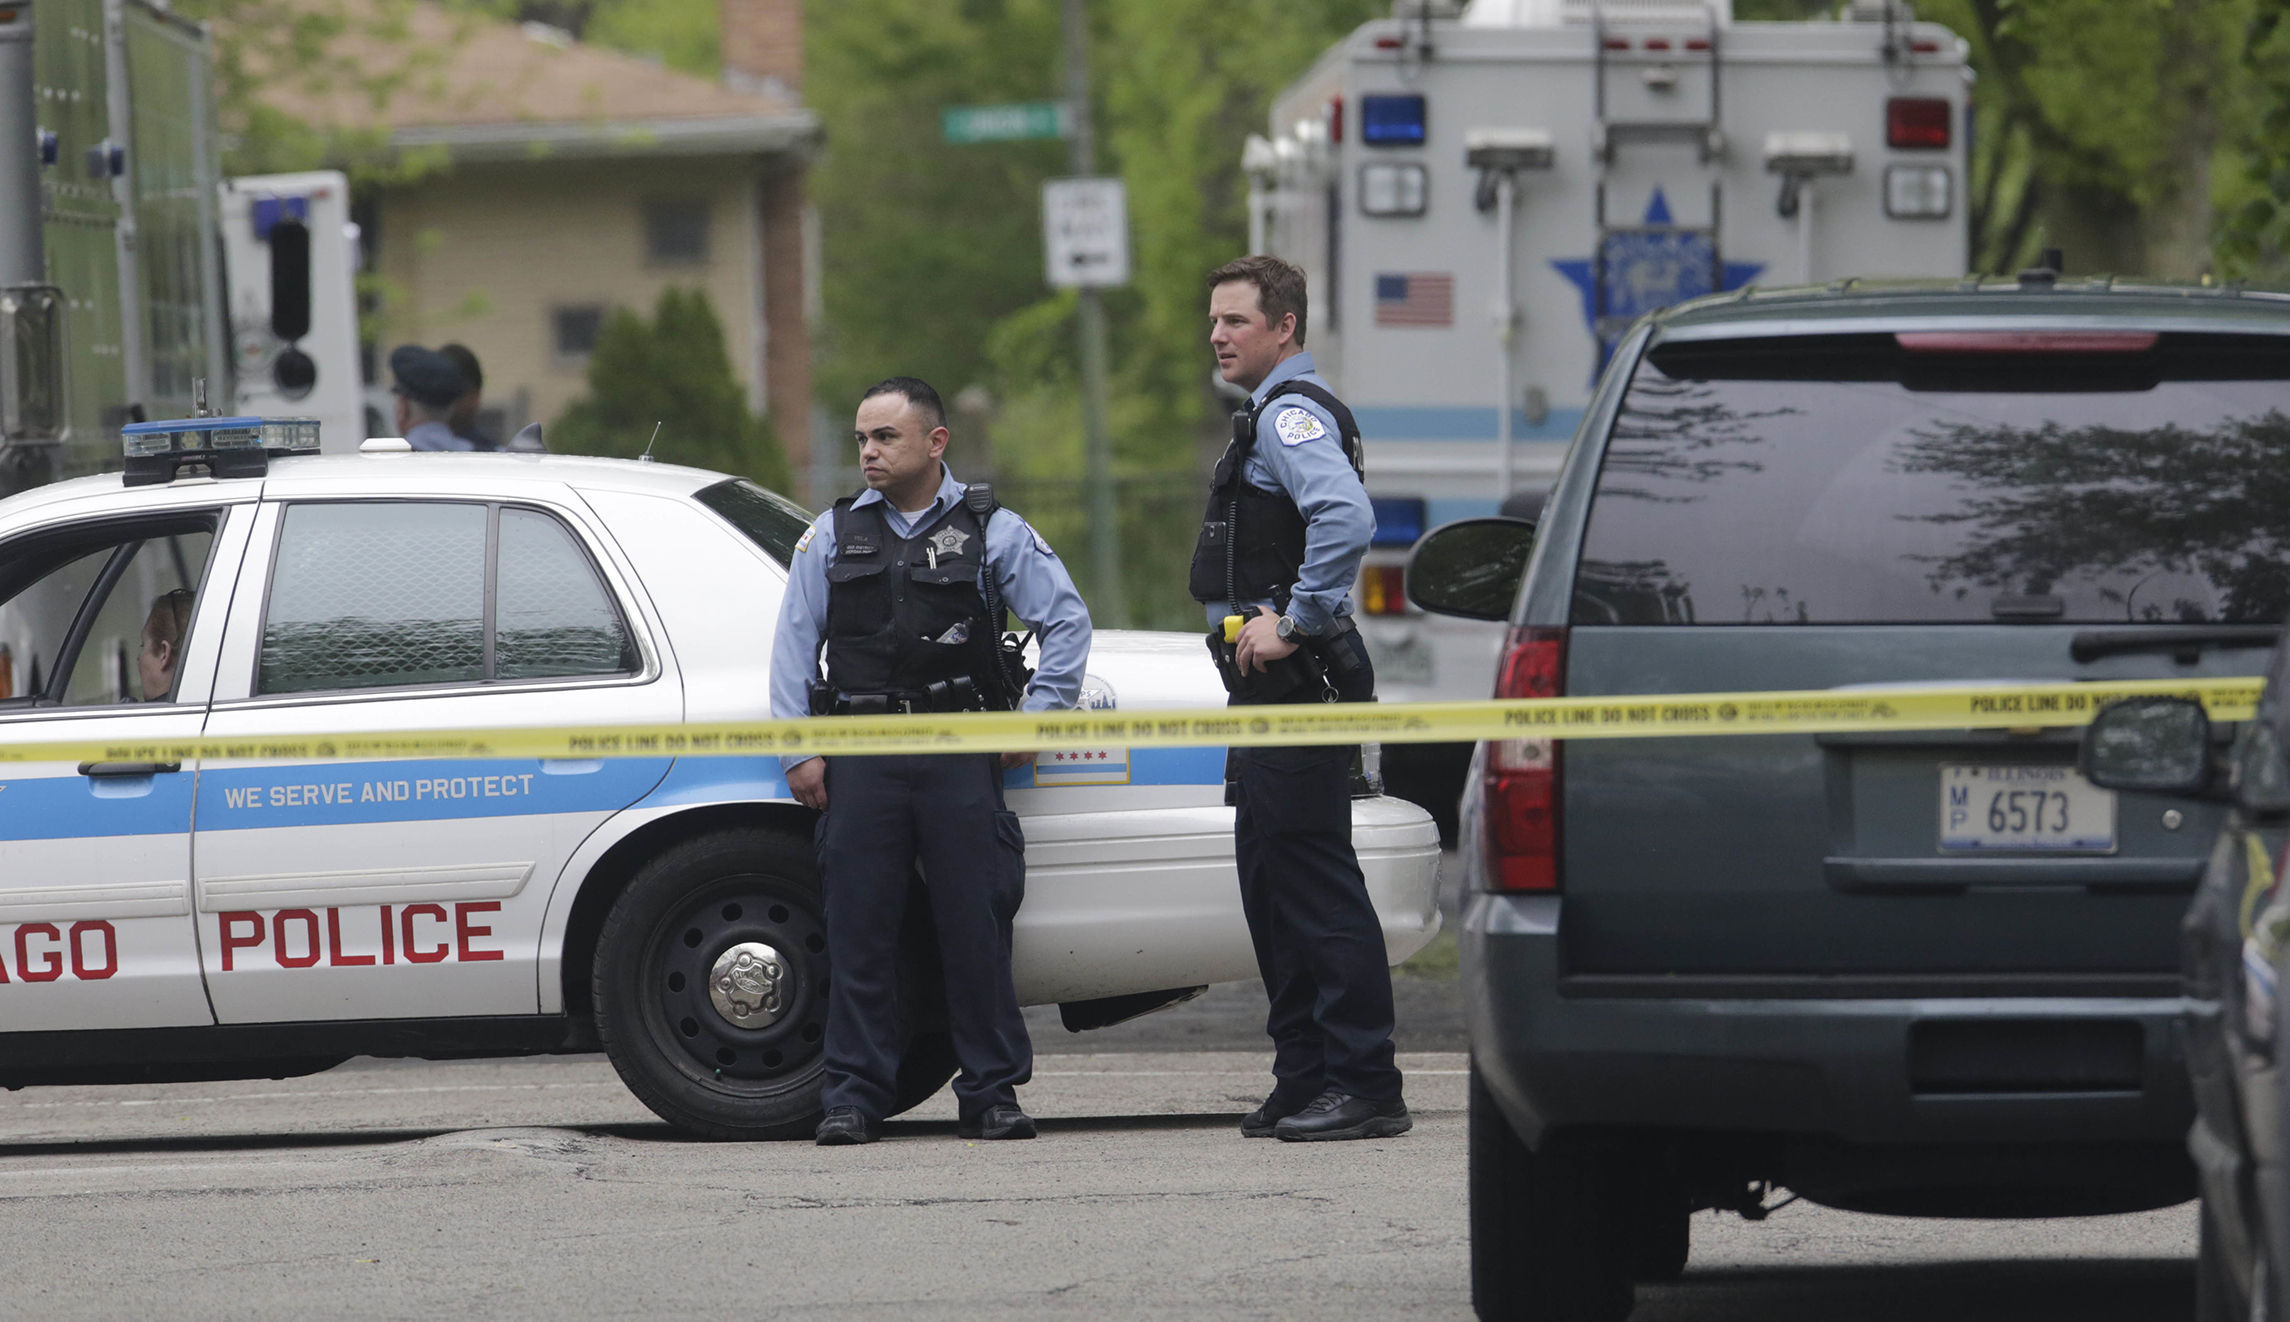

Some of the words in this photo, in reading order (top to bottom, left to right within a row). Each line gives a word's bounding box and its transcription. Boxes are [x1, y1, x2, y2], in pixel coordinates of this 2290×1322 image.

[1280, 409, 1318, 428] CHICAGO
[1287, 426, 1320, 440] POLICE
[1970, 694, 2022, 713] POLICE
[2028, 694, 2060, 712] LINE
[2066, 693, 2086, 711] DO
[1504, 708, 1556, 726] POLICE
[1563, 708, 1594, 724] LINE
[1601, 707, 1621, 723] DO
[1628, 706, 1657, 723] NOT
[1662, 705, 1711, 722] CROSS
[1036, 723, 1088, 739] POLICE
[1094, 722, 1125, 738] LINE
[1132, 721, 1150, 737] DO
[1158, 720, 1187, 736] NOT
[1193, 719, 1241, 735] CROSS
[569, 735, 620, 750] POLICE
[627, 734, 658, 749] LINE
[666, 734, 686, 749] DO
[692, 733, 721, 748] NOT
[726, 732, 773, 747] CROSS
[225, 787, 262, 808] WE
[269, 783, 353, 807] SERVE
[360, 780, 410, 802] AND
[415, 774, 534, 800] PROTECT
[1988, 790, 2070, 832] 6573
[218, 901, 504, 971] POLICE
